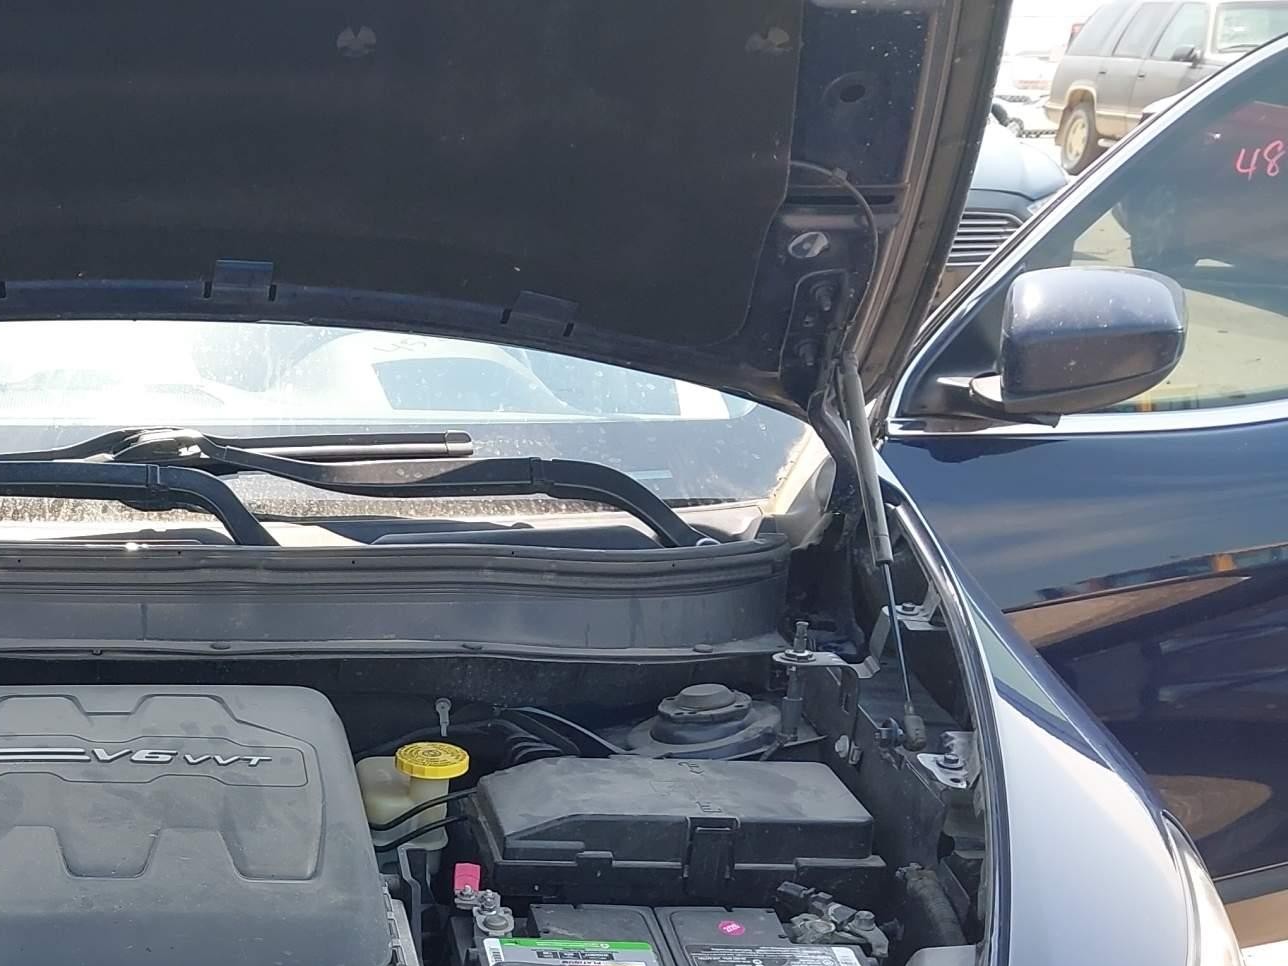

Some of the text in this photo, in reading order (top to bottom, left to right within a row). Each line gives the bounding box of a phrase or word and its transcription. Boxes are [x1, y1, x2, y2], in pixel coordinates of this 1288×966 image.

[1235, 140, 1286, 182] 48
[92, 748, 272, 767] V6 VVT
